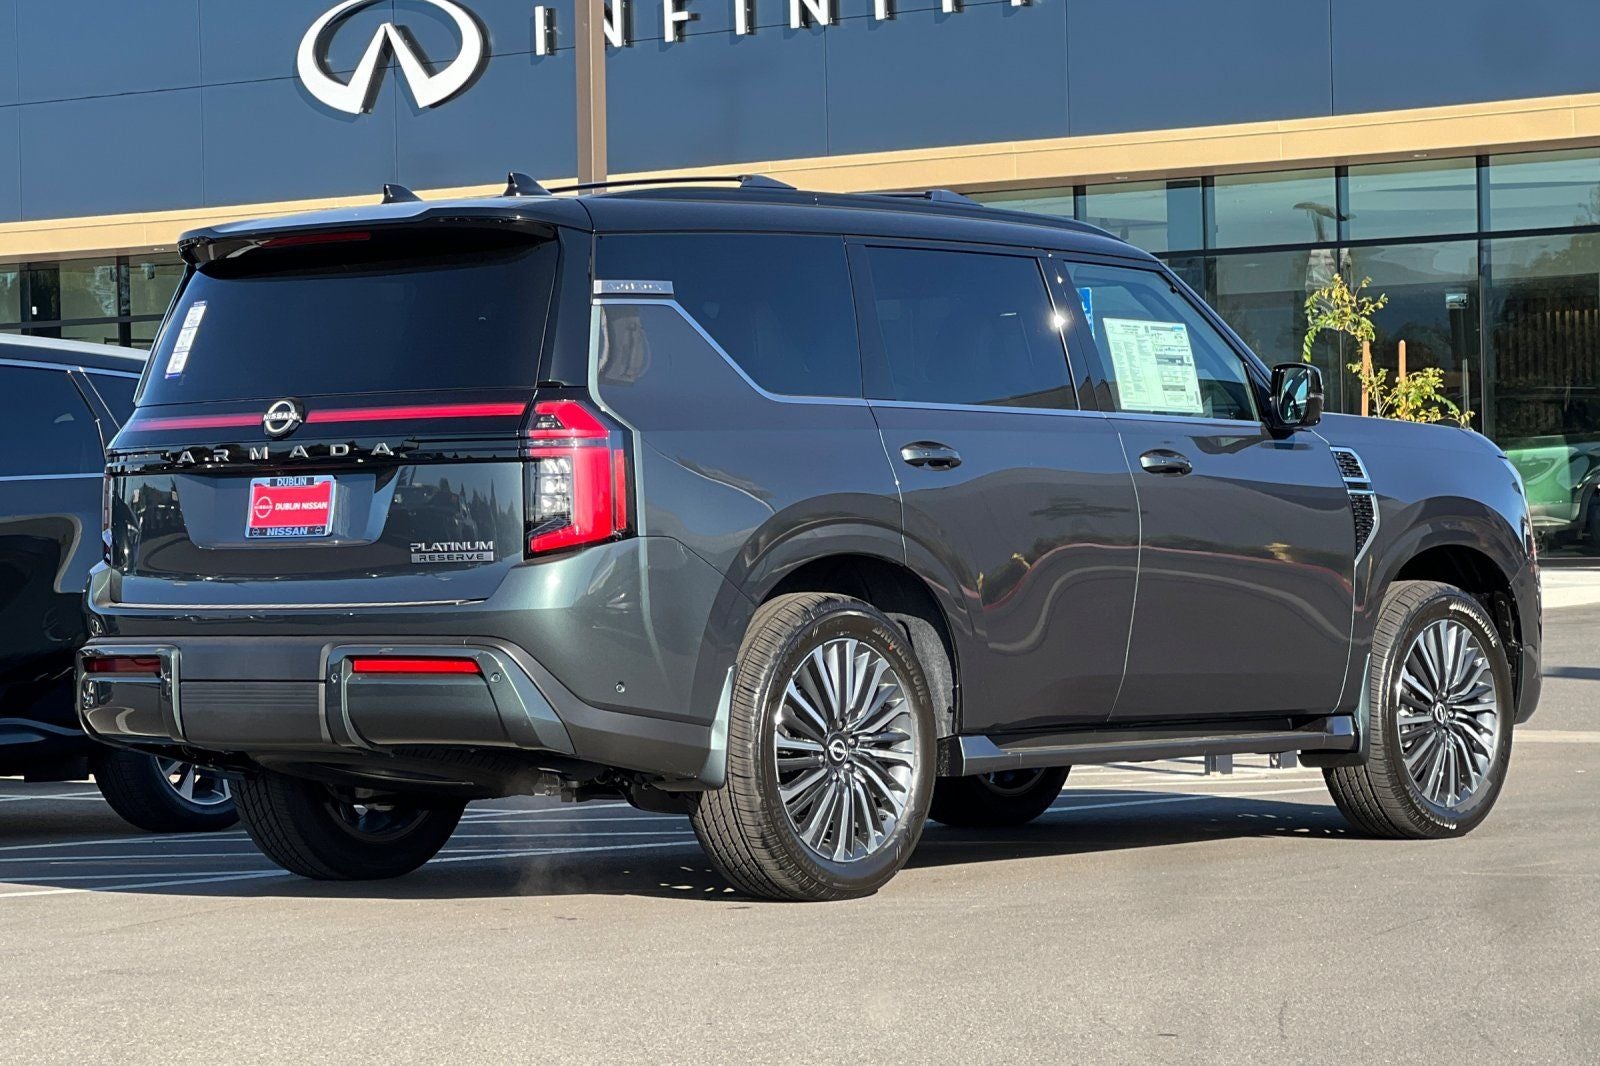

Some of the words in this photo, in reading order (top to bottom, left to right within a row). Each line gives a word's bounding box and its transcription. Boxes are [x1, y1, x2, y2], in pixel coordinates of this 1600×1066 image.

[262, 411, 297, 421] NISSAN
[177, 442, 394, 464] ARMADA
[276, 476, 307, 487] DUBLIN
[274, 502, 301, 511] DUBLIN
[301, 501, 328, 510] NISSAN
[266, 527, 308, 536] NISSAN
[410, 541, 494, 553] PLATINUM
[419, 553, 484, 562] RESERVE
